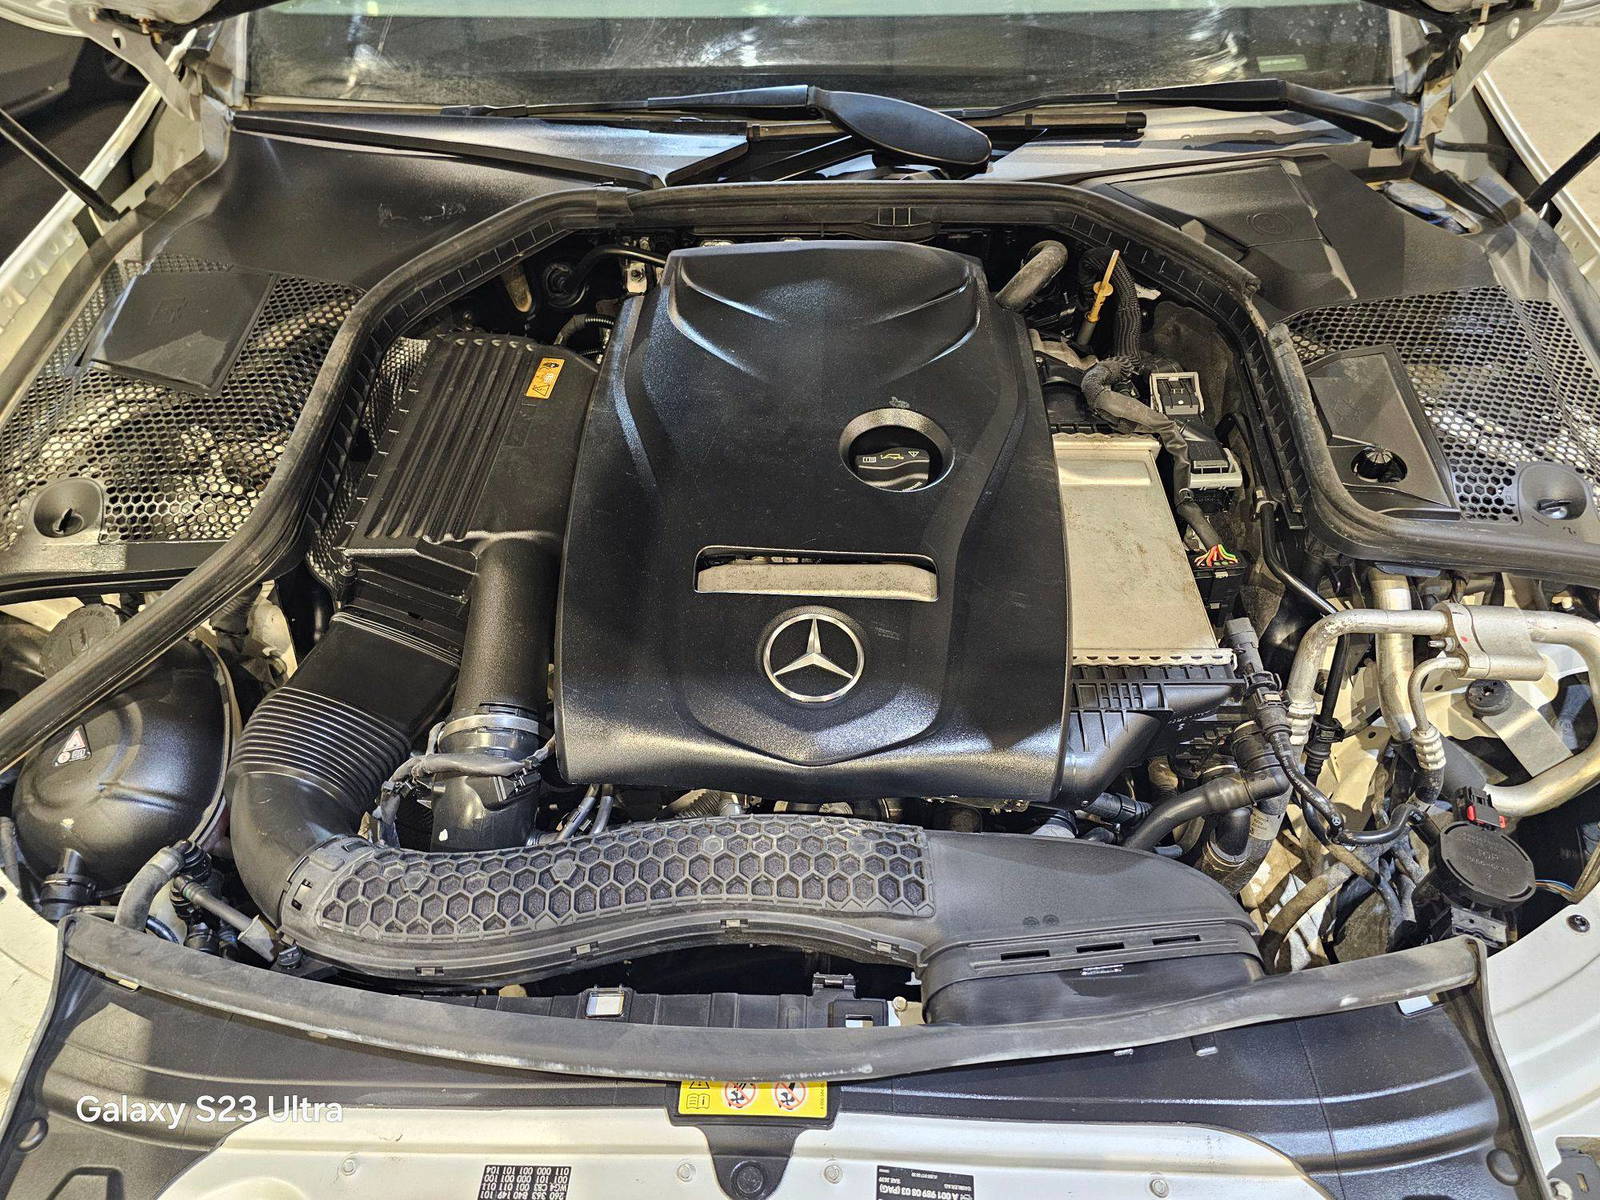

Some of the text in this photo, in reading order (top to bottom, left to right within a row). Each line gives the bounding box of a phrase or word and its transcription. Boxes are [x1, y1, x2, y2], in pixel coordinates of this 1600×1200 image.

[486, 1166, 570, 1176] 011 000 001 101 104
[484, 1174, 568, 1184] 001 101 000 001 100
[498, 1183, 513, 1191] 011
[516, 1183, 530, 1192] 001
[879, 1183, 901, 1195] (PAG)
[901, 1186, 911, 1196] 03
[480, 1190, 493, 1199] 101
[937, 1190, 952, 1200] 001
[951, 1191, 959, 1200] A
